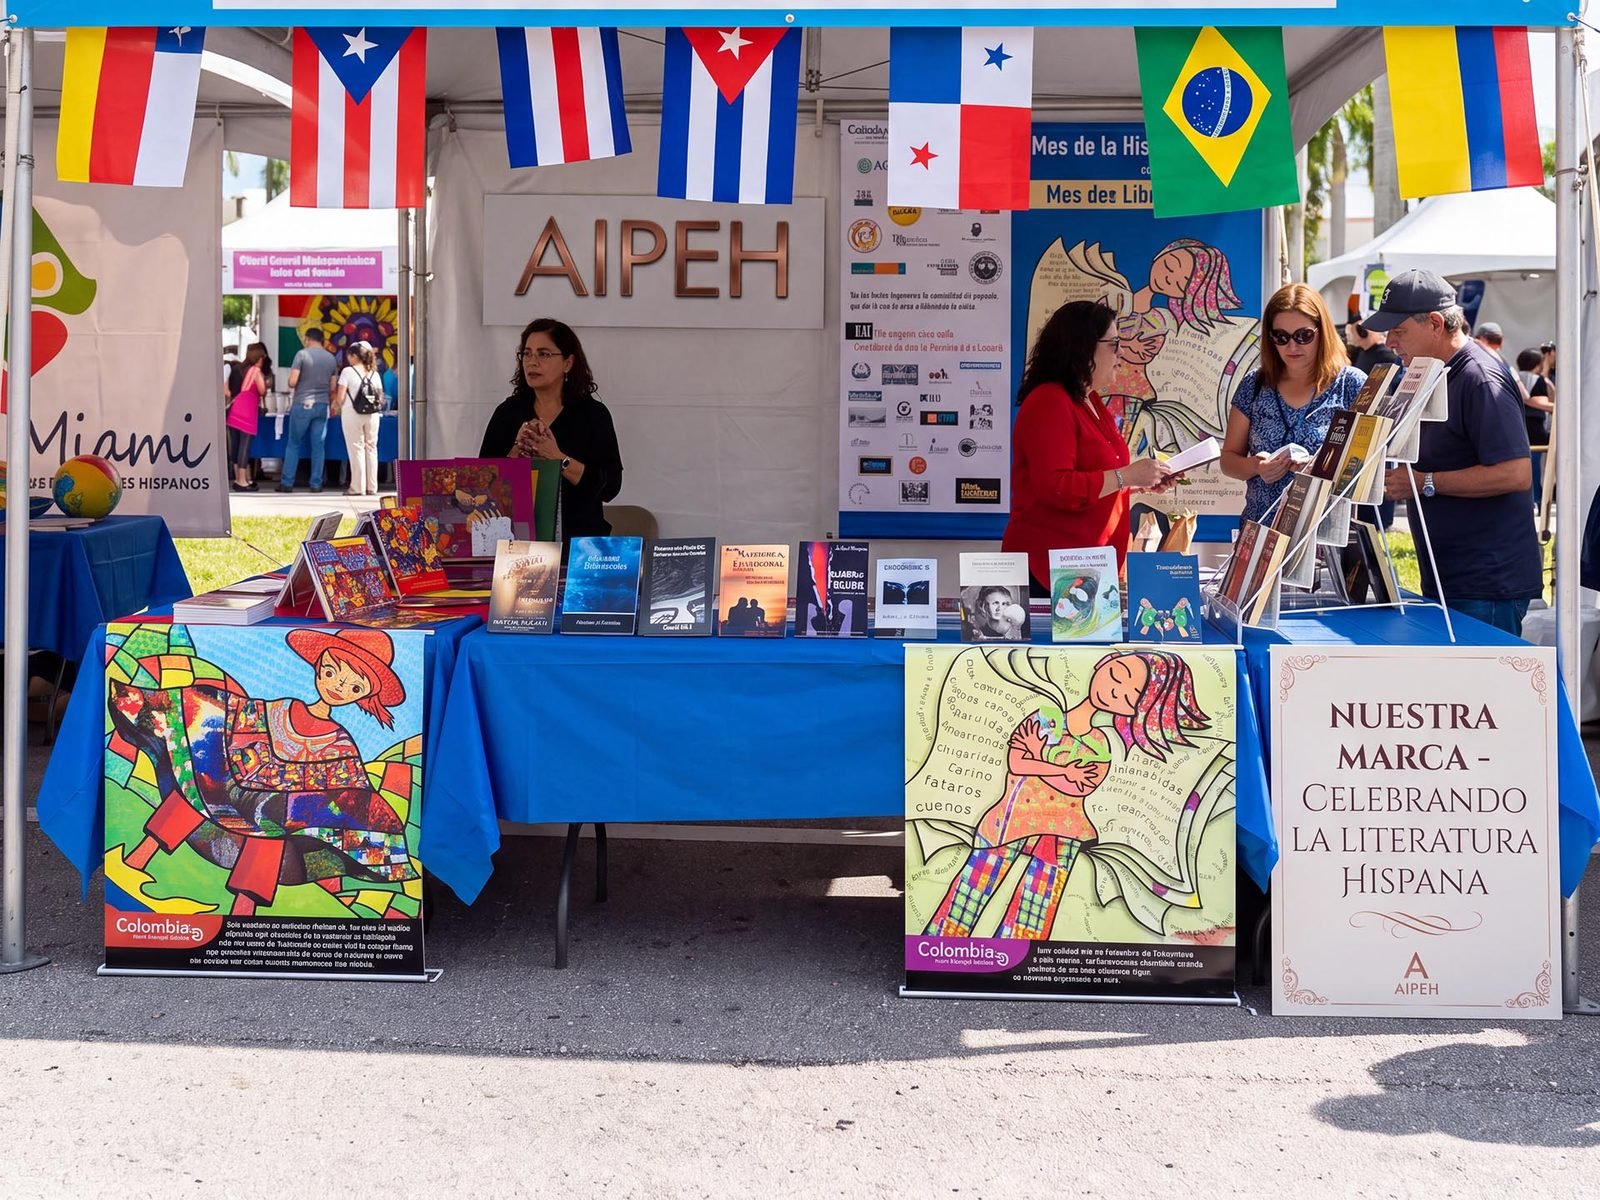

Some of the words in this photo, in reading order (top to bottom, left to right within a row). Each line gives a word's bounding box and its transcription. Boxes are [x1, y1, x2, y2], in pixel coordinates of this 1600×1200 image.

[1032, 136, 1068, 156] Mes
[1074, 136, 1096, 156] de
[1101, 136, 1117, 156] la
[1123, 136, 1149, 156] His
[1141, 166, 1151, 175] co
[1047, 184, 1081, 204] Mes
[514, 215, 790, 298] AIPEH
[30, 411, 211, 468] Miami
[139, 477, 210, 490] HISPANOS
[1329, 702, 1498, 730] NUESTRA
[1336, 743, 1470, 770] MARCA
[915, 801, 972, 815] cuenos
[1302, 783, 1527, 814] CELEBRANDO
[1292, 827, 1331, 852] LA
[1341, 827, 1539, 854] LITERATURA
[1341, 863, 1490, 898] HISPANA
[116, 917, 190, 934] Colombia
[918, 941, 994, 959] Colombia
[1403, 951, 1429, 979] A
[1394, 982, 1439, 995] AIPEH
